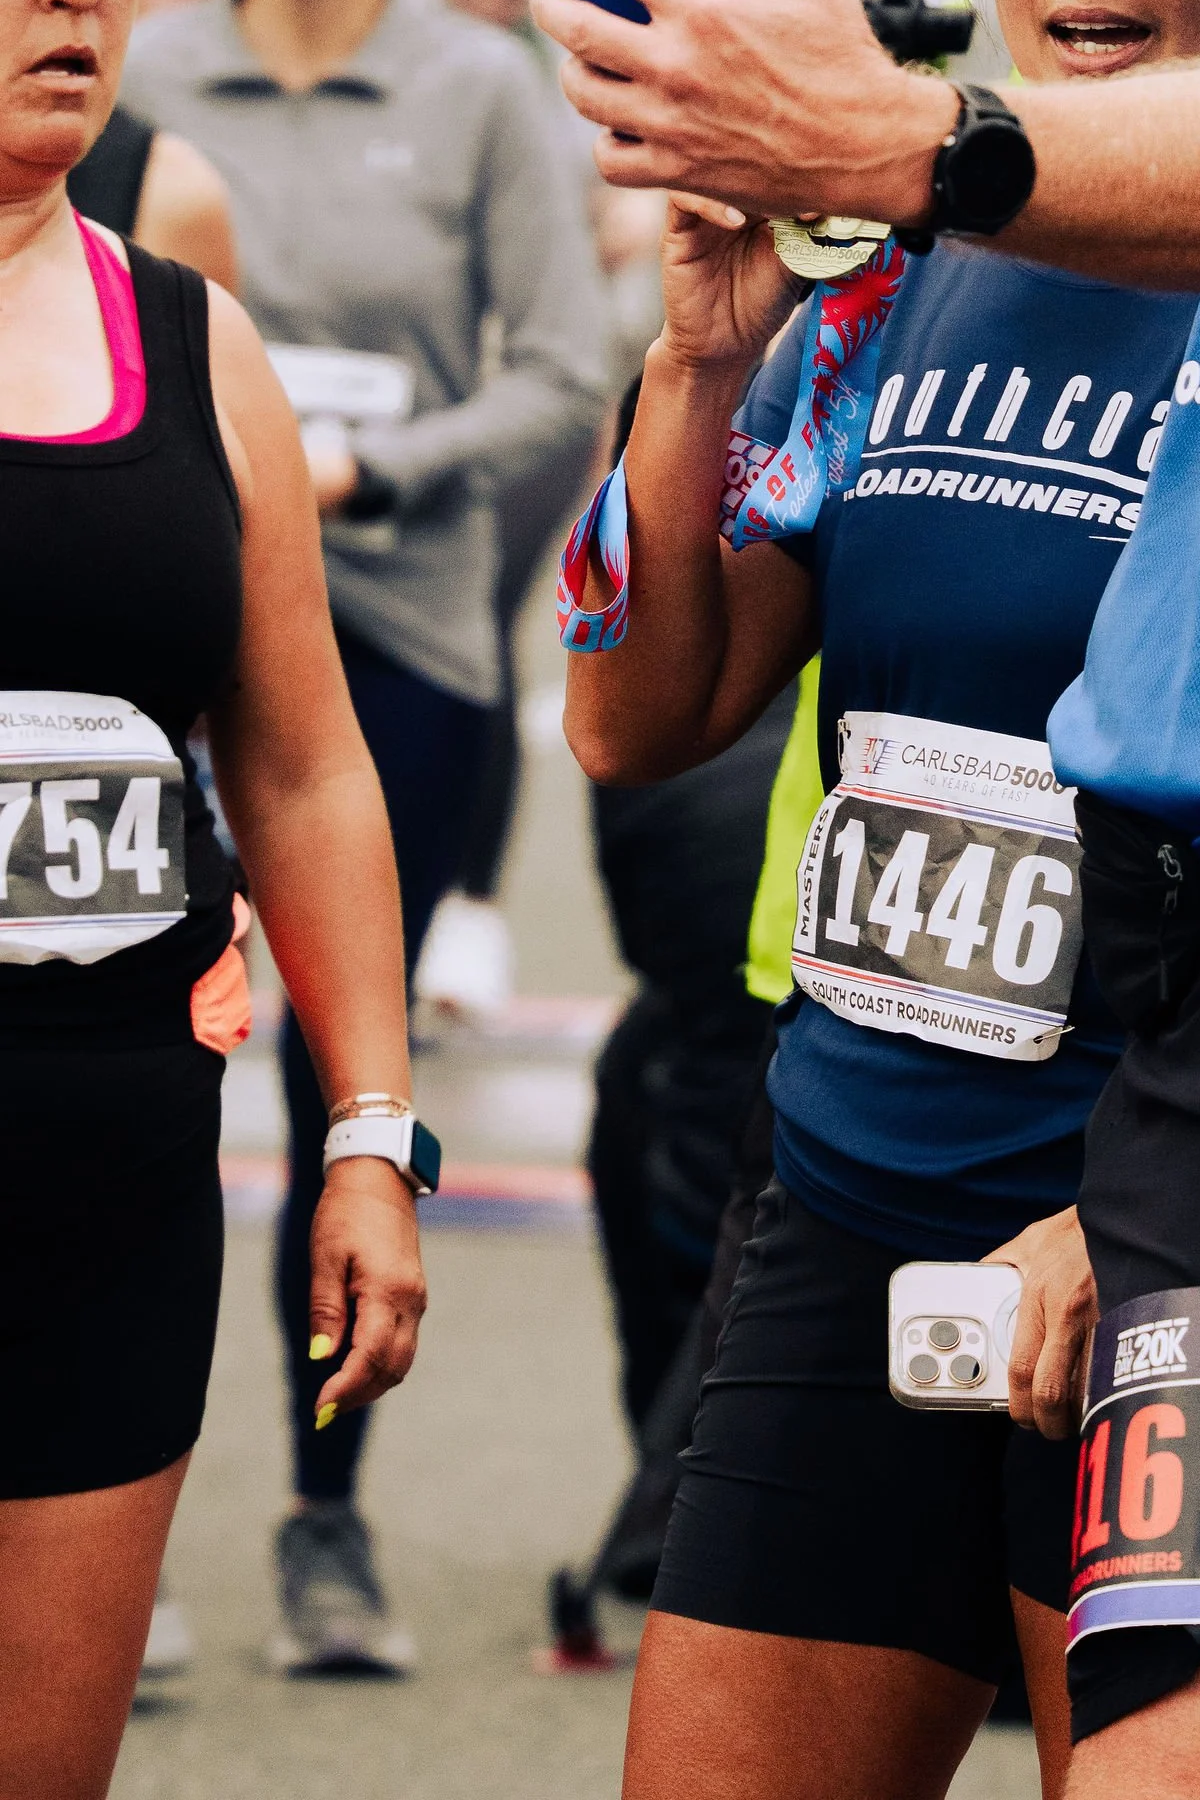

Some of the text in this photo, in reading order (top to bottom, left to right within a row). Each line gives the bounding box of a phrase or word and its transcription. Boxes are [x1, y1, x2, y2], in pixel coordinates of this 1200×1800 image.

[775, 242, 868, 261] CARLSBAD5000
[923, 774, 1031, 802] 40 YEARS OF FAST
[0, 776, 170, 899] 754
[800, 807, 829, 937] MASTERS
[825, 818, 1073, 986] 1446
[811, 980, 1017, 1044] SOUTH COAST ROADRUNNERS
[1132, 1326, 1189, 1370] 20K
[1071, 1403, 1186, 1570] 16
